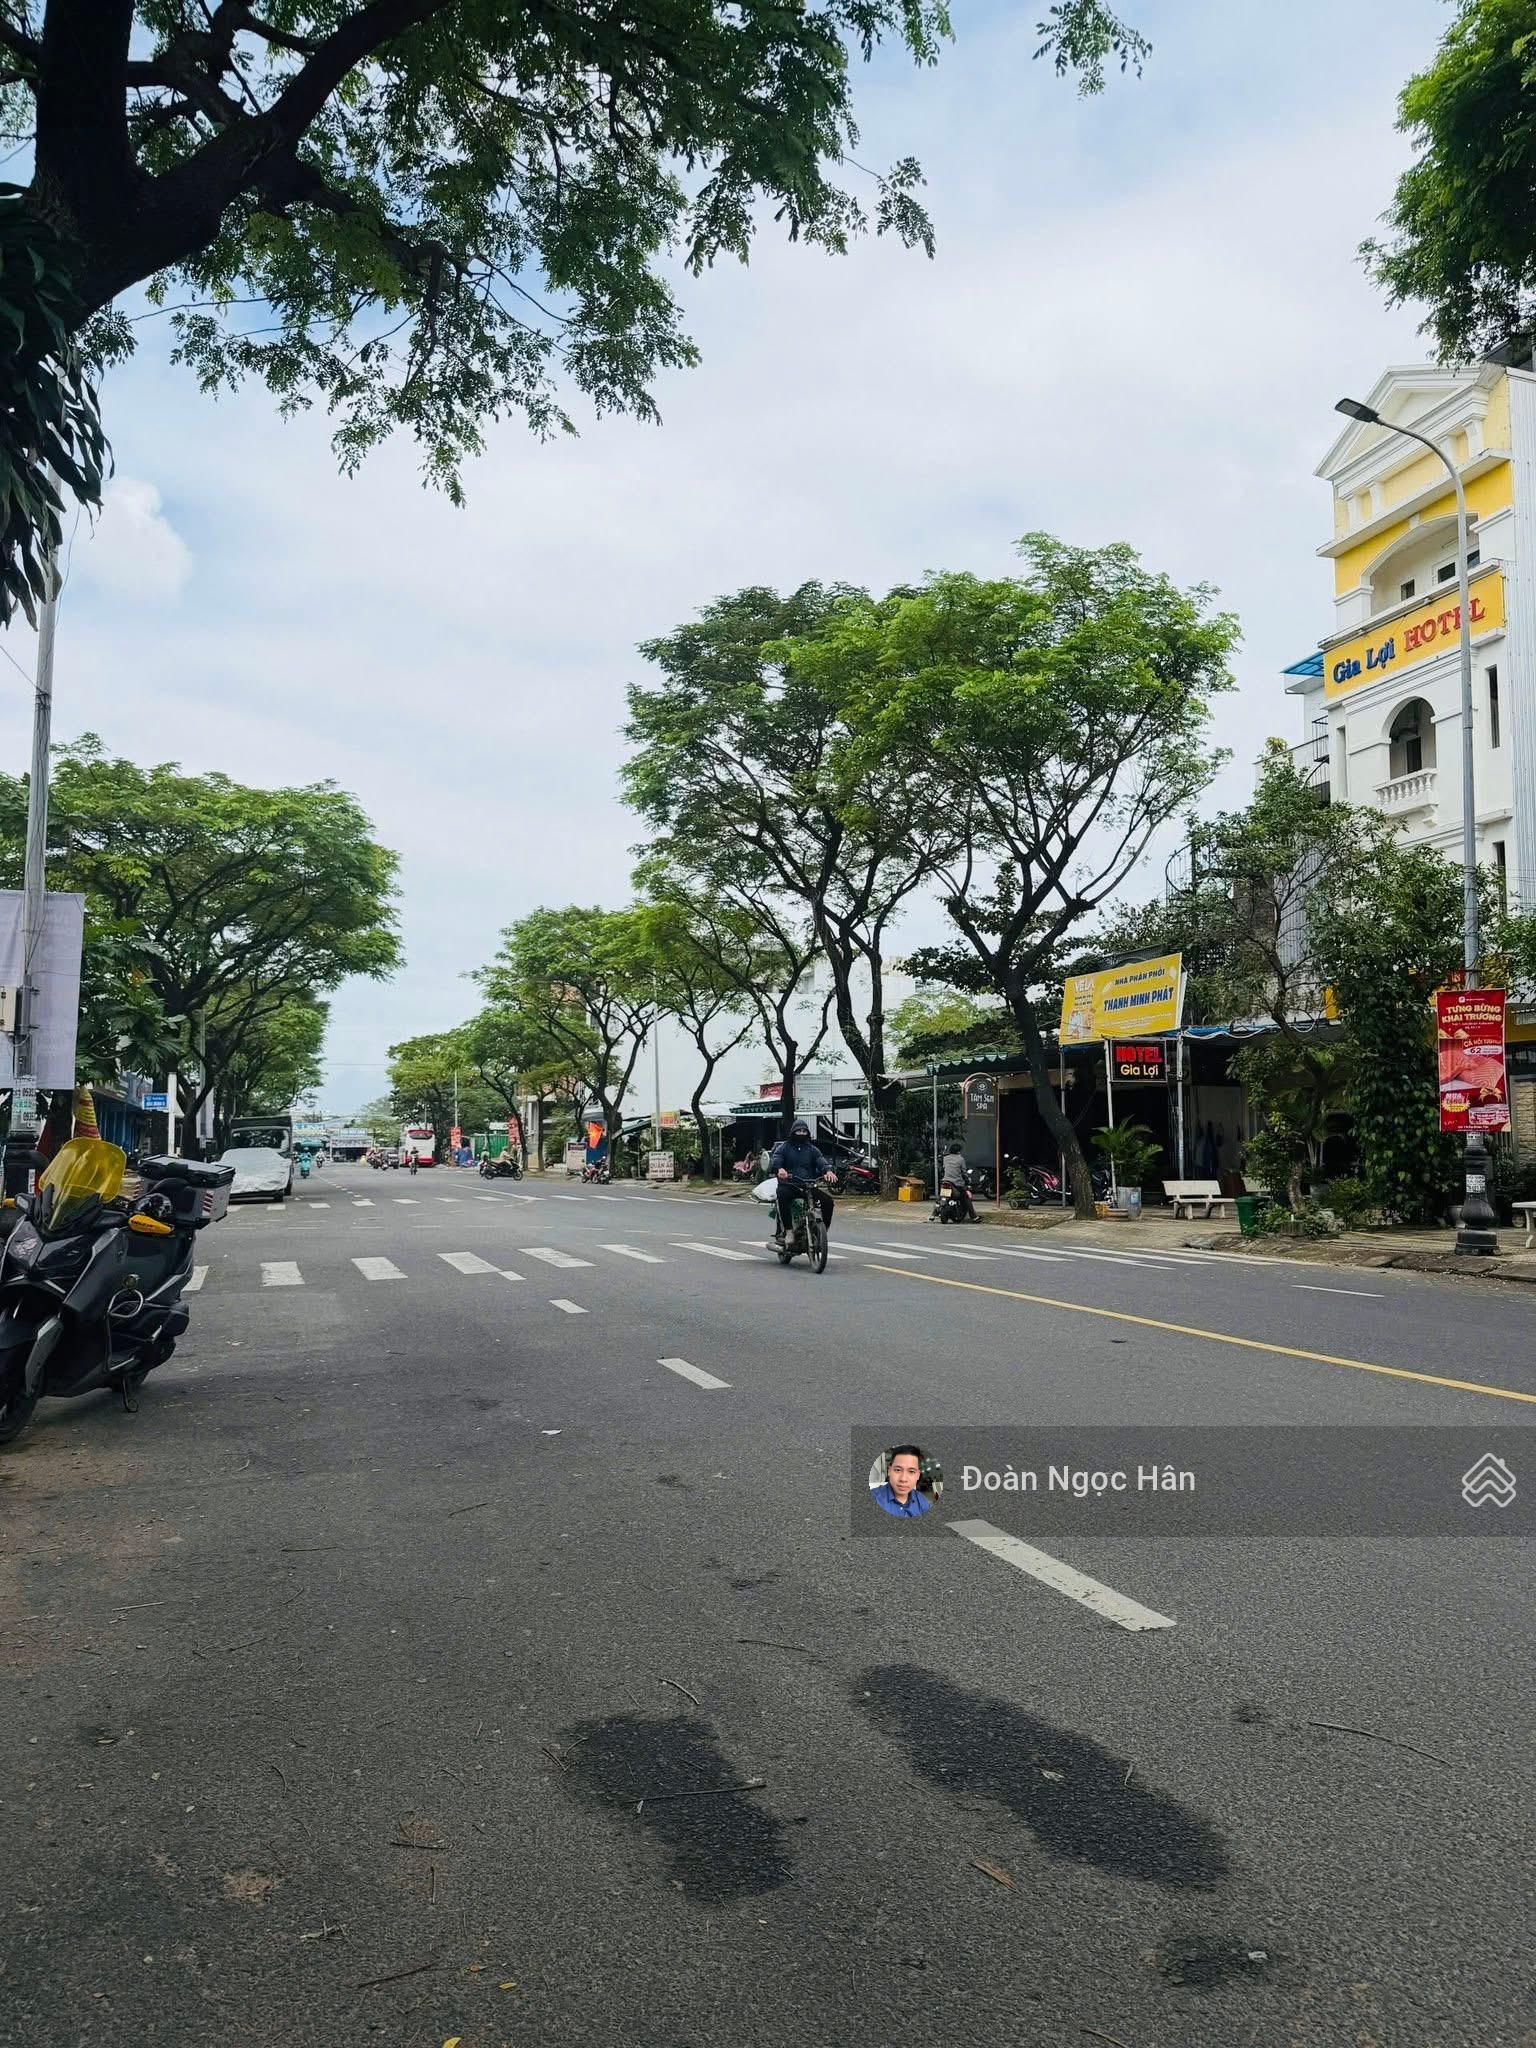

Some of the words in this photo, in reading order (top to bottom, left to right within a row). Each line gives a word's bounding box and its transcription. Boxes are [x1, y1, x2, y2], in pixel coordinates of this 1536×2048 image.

[1333, 659, 1362, 684] Gia
[1366, 637, 1396, 669] Lợi
[1104, 995, 1129, 1011] THANH
[1129, 992, 1150, 1007] MINH
[1152, 985, 1174, 1003] PHÁT
[1441, 1014, 1463, 1023] KHAI
[1115, 1046, 1162, 1062] HOTEL
[1120, 1064, 1140, 1076] Gia
[1143, 1064, 1159, 1078] Lợi
